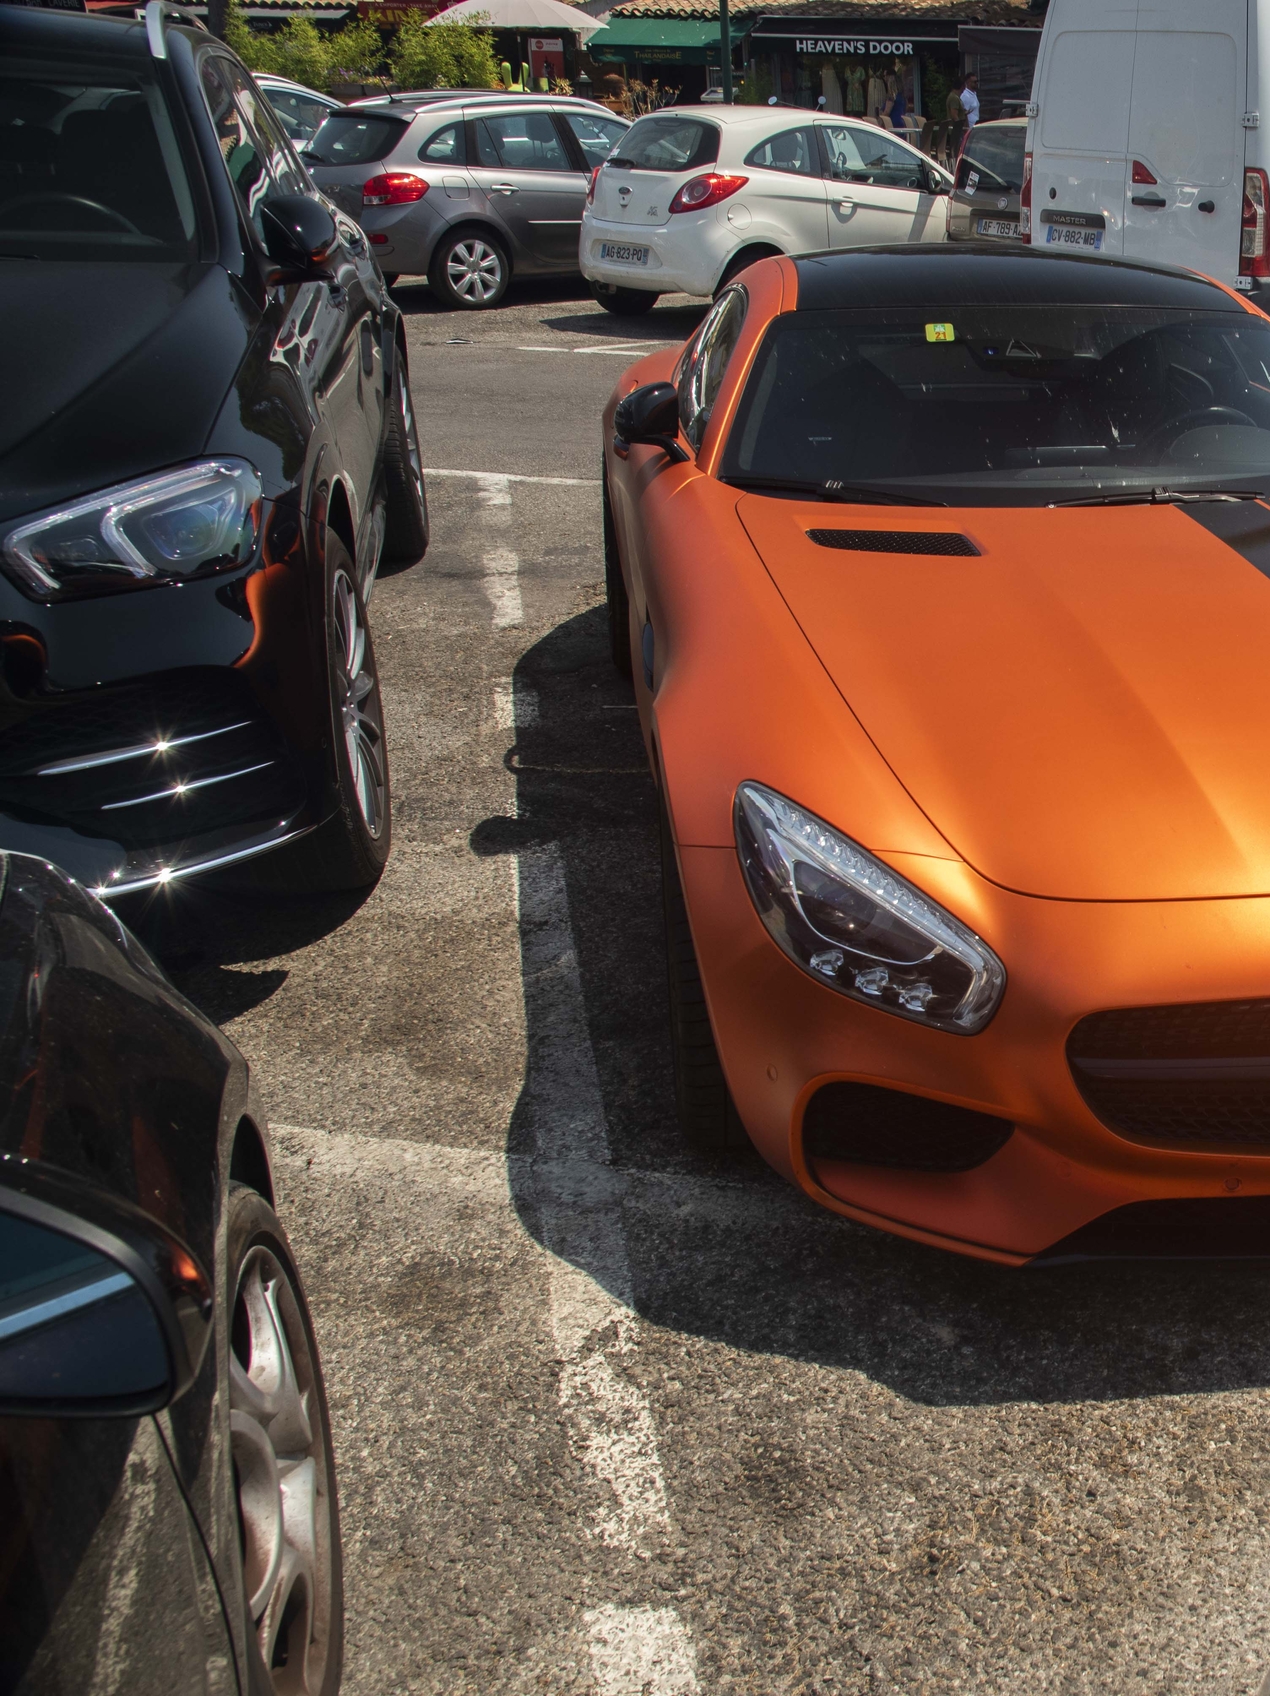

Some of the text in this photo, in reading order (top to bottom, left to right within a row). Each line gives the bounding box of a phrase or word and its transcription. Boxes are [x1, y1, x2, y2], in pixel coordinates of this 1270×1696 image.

[796, 40, 913, 55] HEAVEN'S DOOR
[1053, 215, 1087, 225] MASTER
[1052, 228, 1096, 246] CV-882-MB
[935, 331, 947, 339] 21
